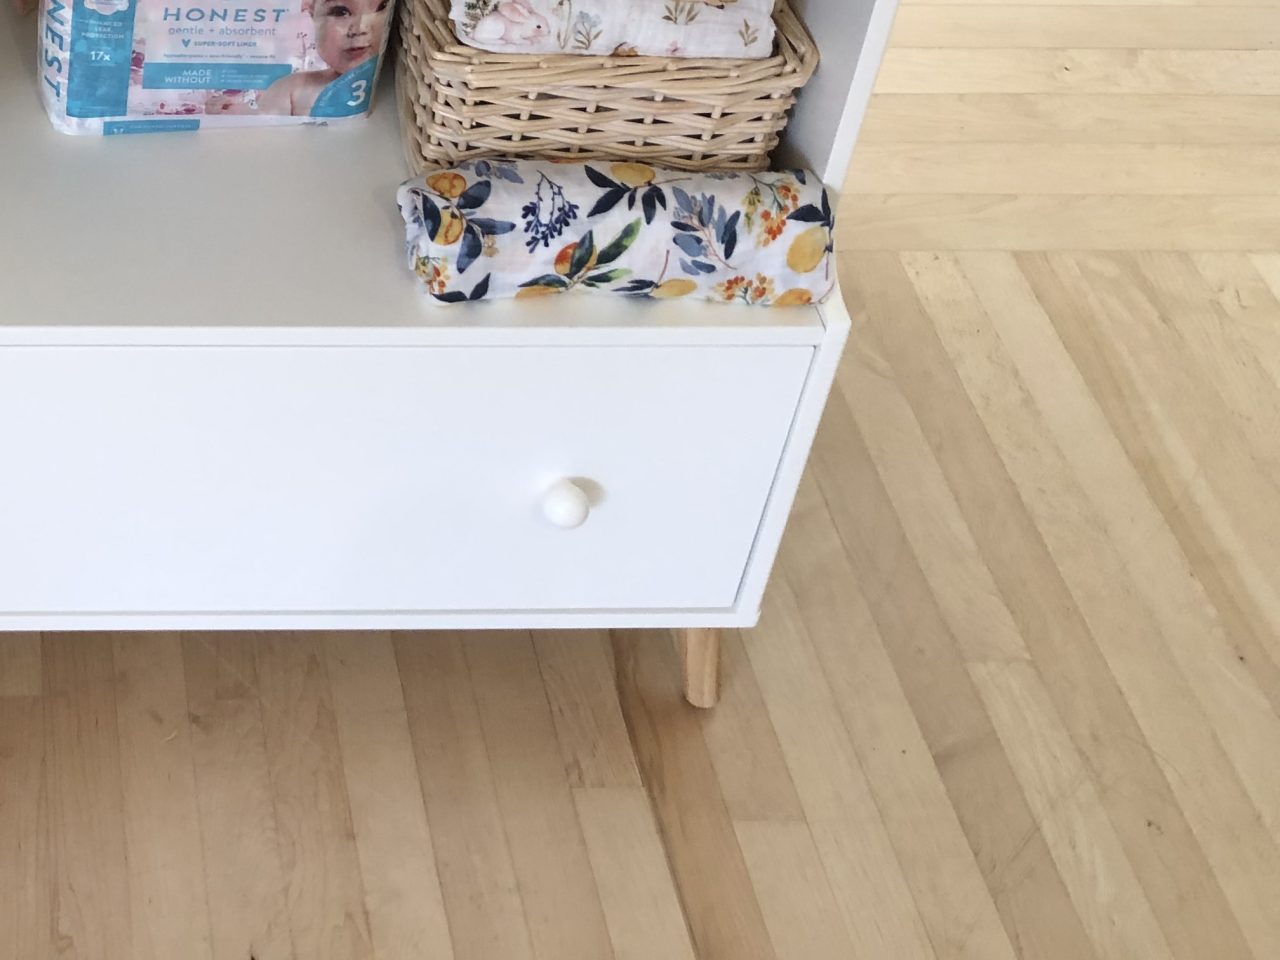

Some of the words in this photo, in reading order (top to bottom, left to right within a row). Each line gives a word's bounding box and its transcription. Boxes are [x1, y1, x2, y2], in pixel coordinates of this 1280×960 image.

[163, 7, 287, 23] HONEST
[168, 25, 205, 36] gentle
[219, 25, 277, 36] absorbent
[90, 50, 111, 61] 17x
[164, 76, 212, 84] WITHOUT
[346, 79, 367, 107] 3
